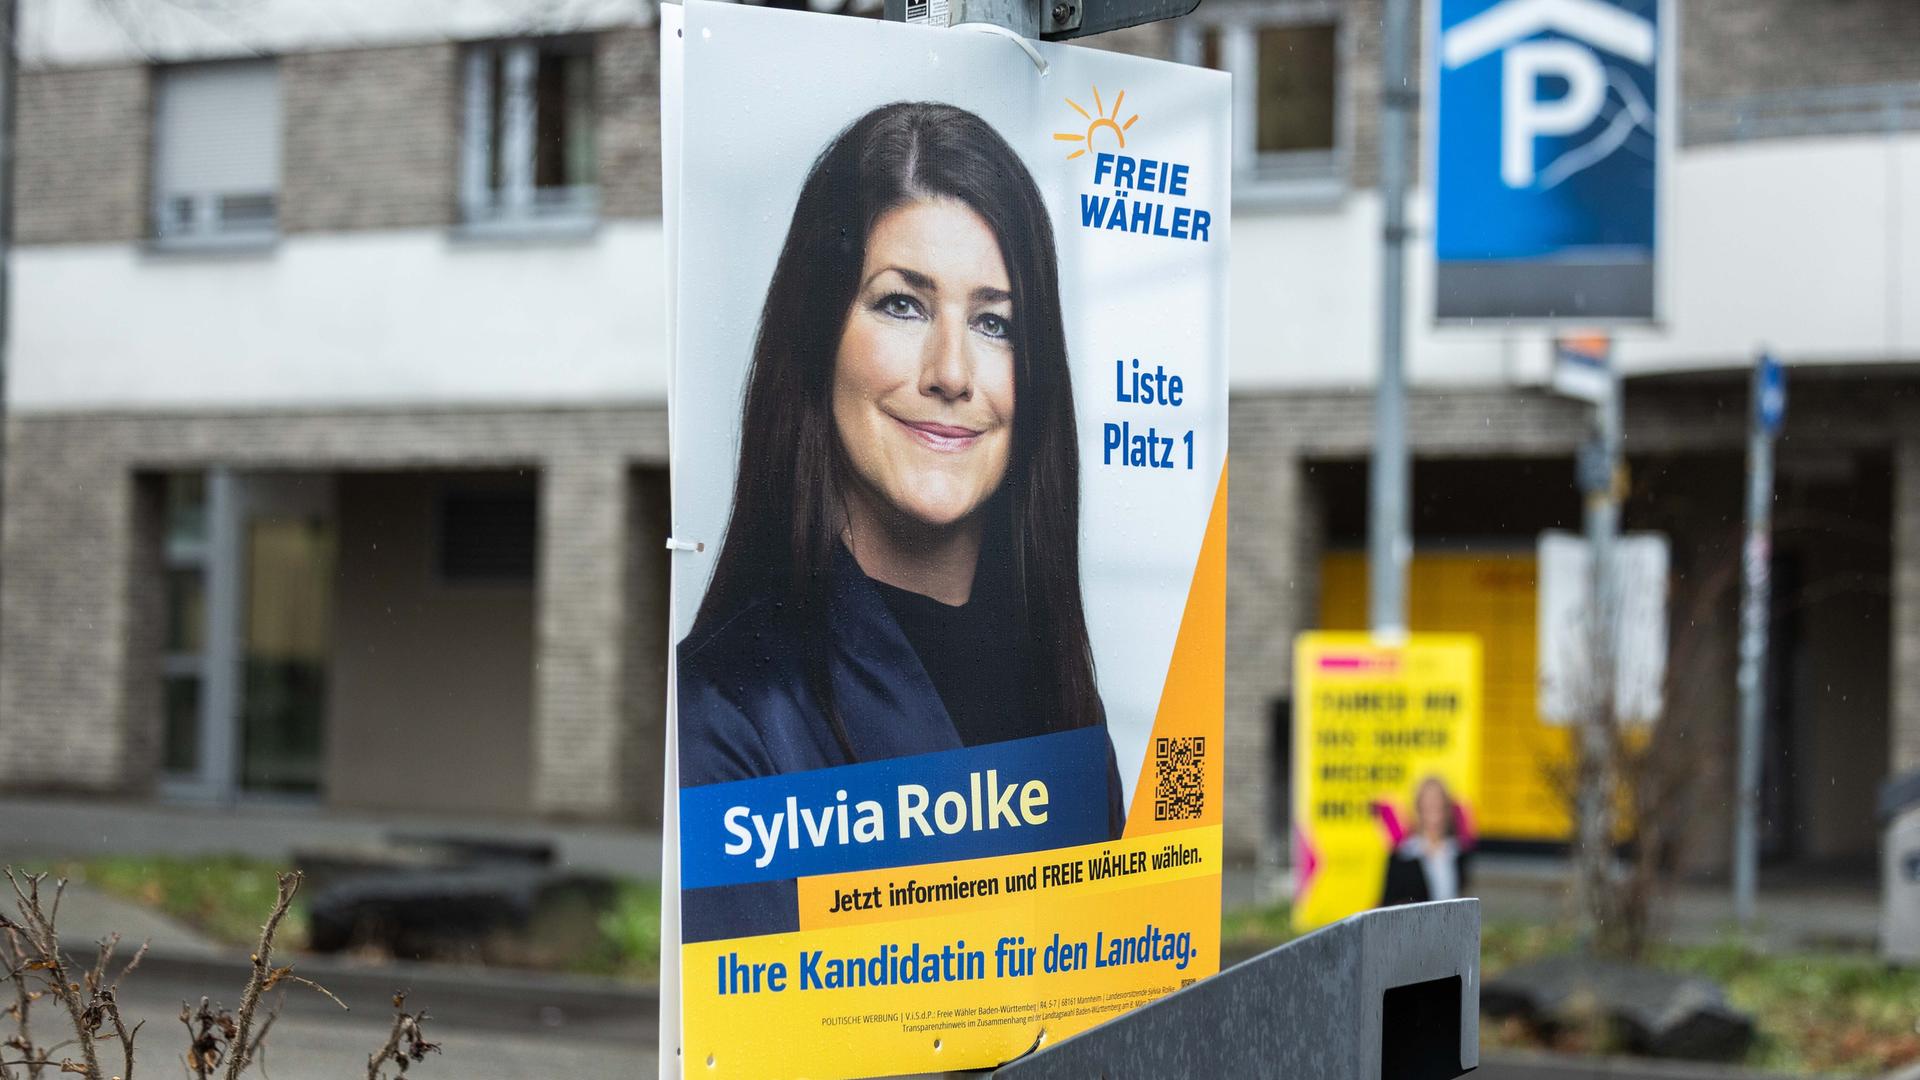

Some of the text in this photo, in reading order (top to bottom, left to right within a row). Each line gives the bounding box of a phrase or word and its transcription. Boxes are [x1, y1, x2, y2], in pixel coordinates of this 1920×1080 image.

[1500, 40, 1608, 189] P
[1093, 152, 1190, 197] FREIE
[1080, 190, 1212, 242] WÄHLER
[1116, 358, 1184, 407] Liste
[1103, 421, 1194, 471] Platz 1
[724, 769, 1049, 868] Sylvia Rolke
[829, 843, 1202, 913] Jetzt informieren und FREIE WÄHLER wählen.
[718, 924, 1197, 994] Ihre Kandidatin für den Landtag.
[821, 1016, 862, 1026] POLITISCHE
[862, 1012, 899, 1024] WERBUNG
[936, 1009, 954, 1019] Freie
[954, 1007, 977, 1018] Wähler
[1077, 995, 1102, 1005] Mannheim
[903, 1020, 966, 1032] Transparenzhinweis
[967, 1020, 977, 1028] im
[976, 1014, 1027, 1027] Zusammenhang
